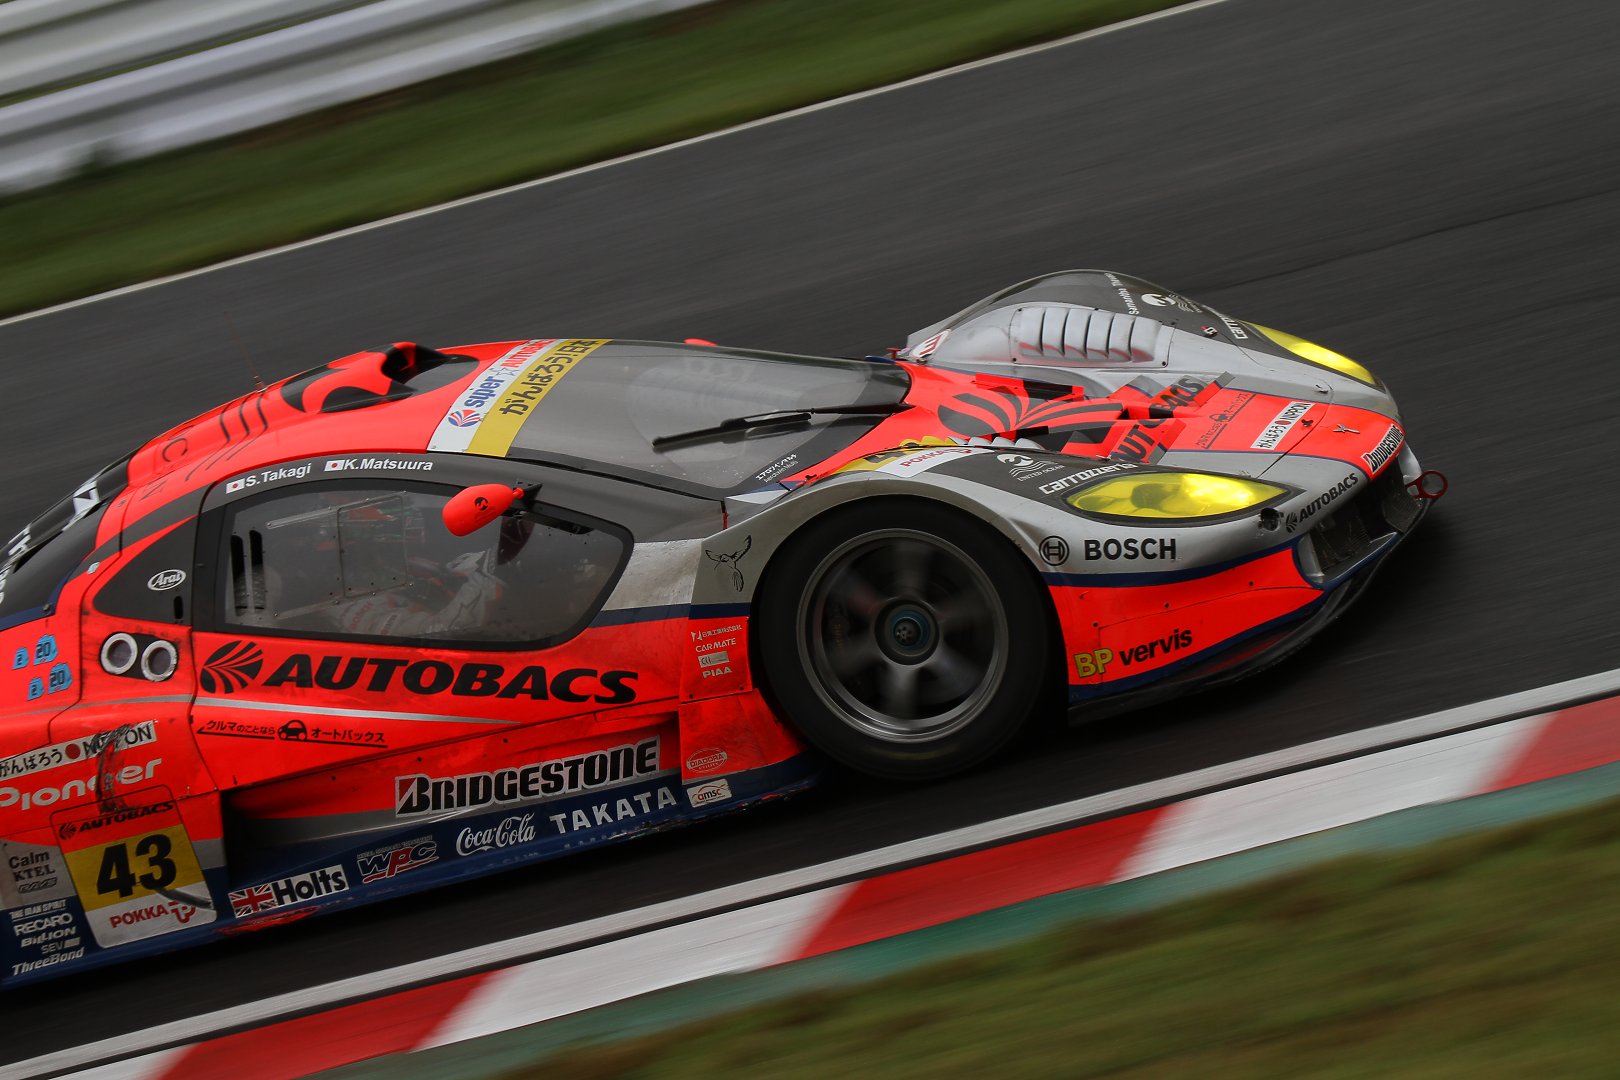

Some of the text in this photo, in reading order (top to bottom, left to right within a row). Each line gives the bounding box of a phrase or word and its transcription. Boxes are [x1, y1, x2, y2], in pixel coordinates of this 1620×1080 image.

[464, 376, 504, 408] super
[245, 463, 312, 488] S.Takagi
[343, 458, 434, 472] K.Matsuura
[1038, 463, 1139, 496] carrozzeria
[1299, 472, 1359, 524] AUTOBACS
[1084, 538, 1177, 561] BOSCH
[153, 572, 182, 586] Arai
[1073, 627, 1193, 679] BP vervis
[261, 653, 639, 704] AUTOBACS
[702, 666, 733, 679] PIAA
[205, 719, 385, 743] クルマのことなら オートバックス
[396, 737, 660, 817] BRIDGESTONE
[697, 786, 722, 801] amsc
[79, 802, 174, 832] AUTOBACS
[549, 786, 677, 834] TAKATA
[456, 812, 536, 857] Coca-Cola
[9, 852, 50, 869] Calm
[14, 864, 56, 882] KTEL
[97, 834, 177, 898] 43
[356, 840, 438, 879] WPC
[271, 869, 347, 906] Holts
[14, 912, 73, 937] RECARO
[109, 904, 170, 928] POKKA
[12, 946, 85, 977] ThreeBond
[41, 941, 65, 954] SEV
